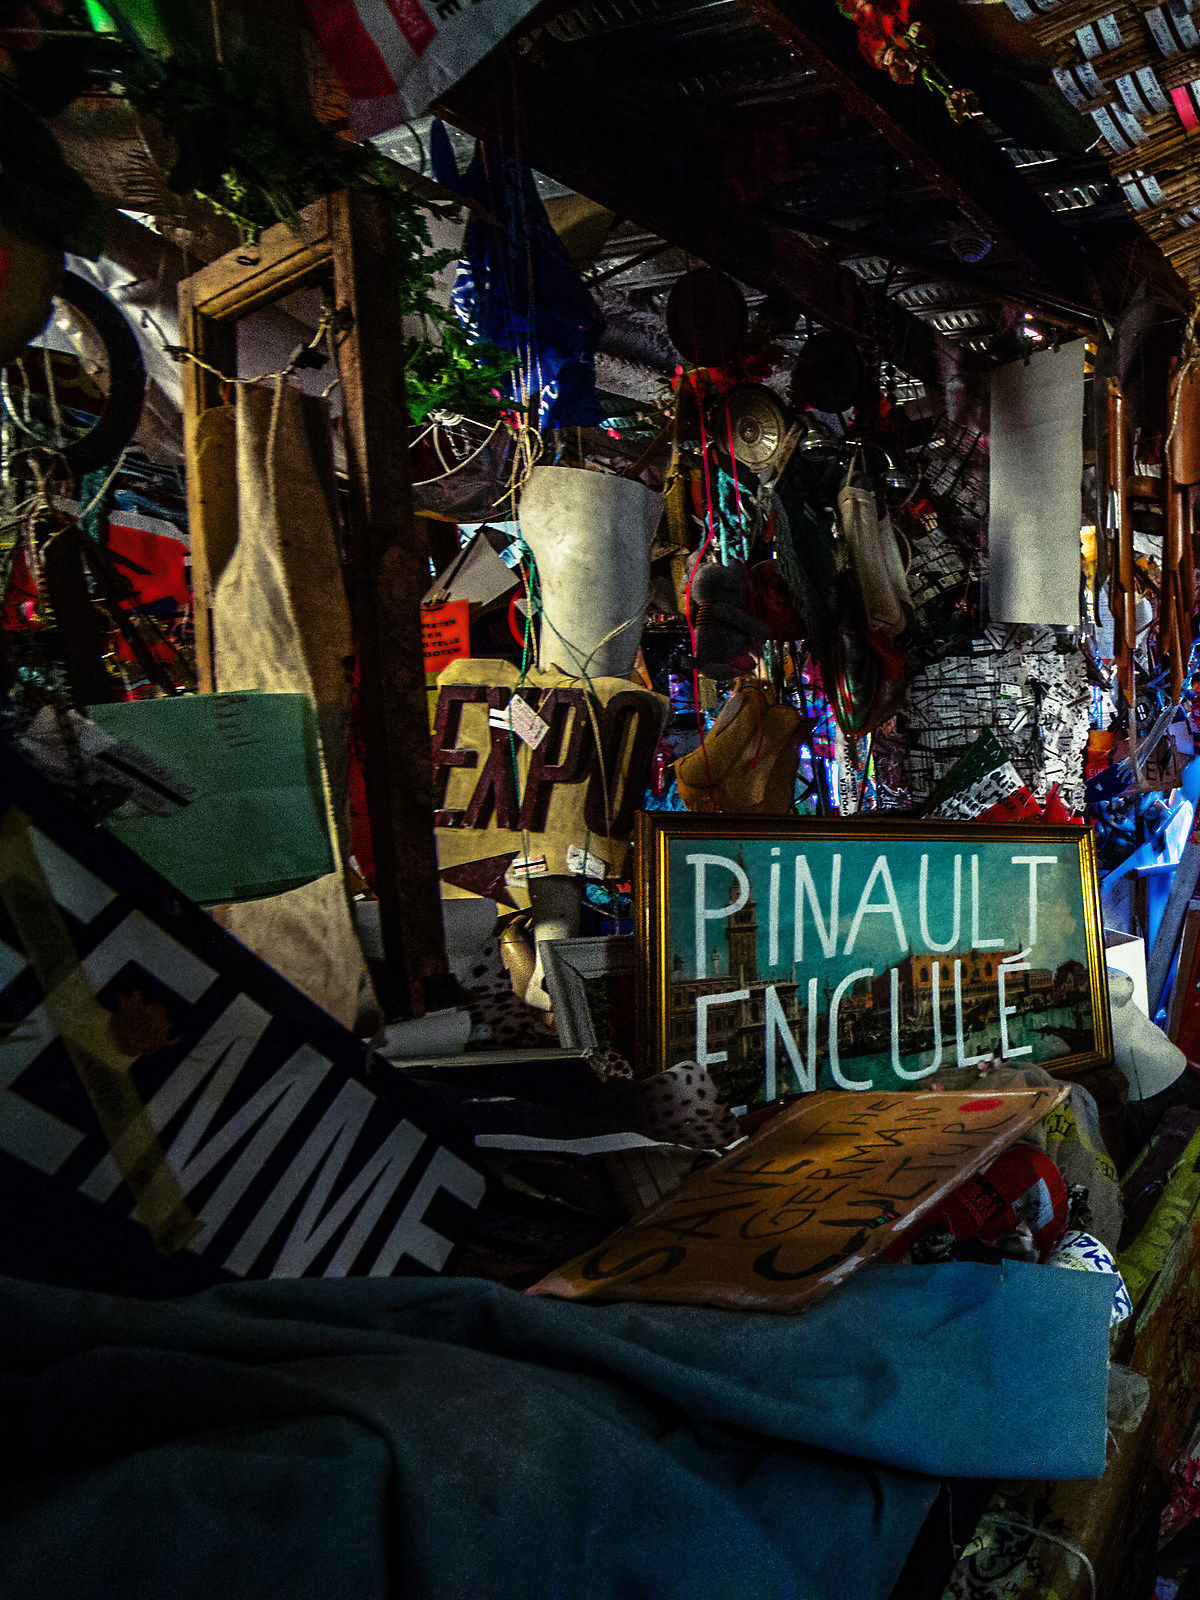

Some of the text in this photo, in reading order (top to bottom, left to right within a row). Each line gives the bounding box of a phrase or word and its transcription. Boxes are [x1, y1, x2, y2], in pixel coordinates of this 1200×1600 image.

[694, 946, 1034, 1115] ENCULÉ
[582, 1098, 904, 1284] SAVE THE
[738, 1104, 942, 1240] GERMAN
